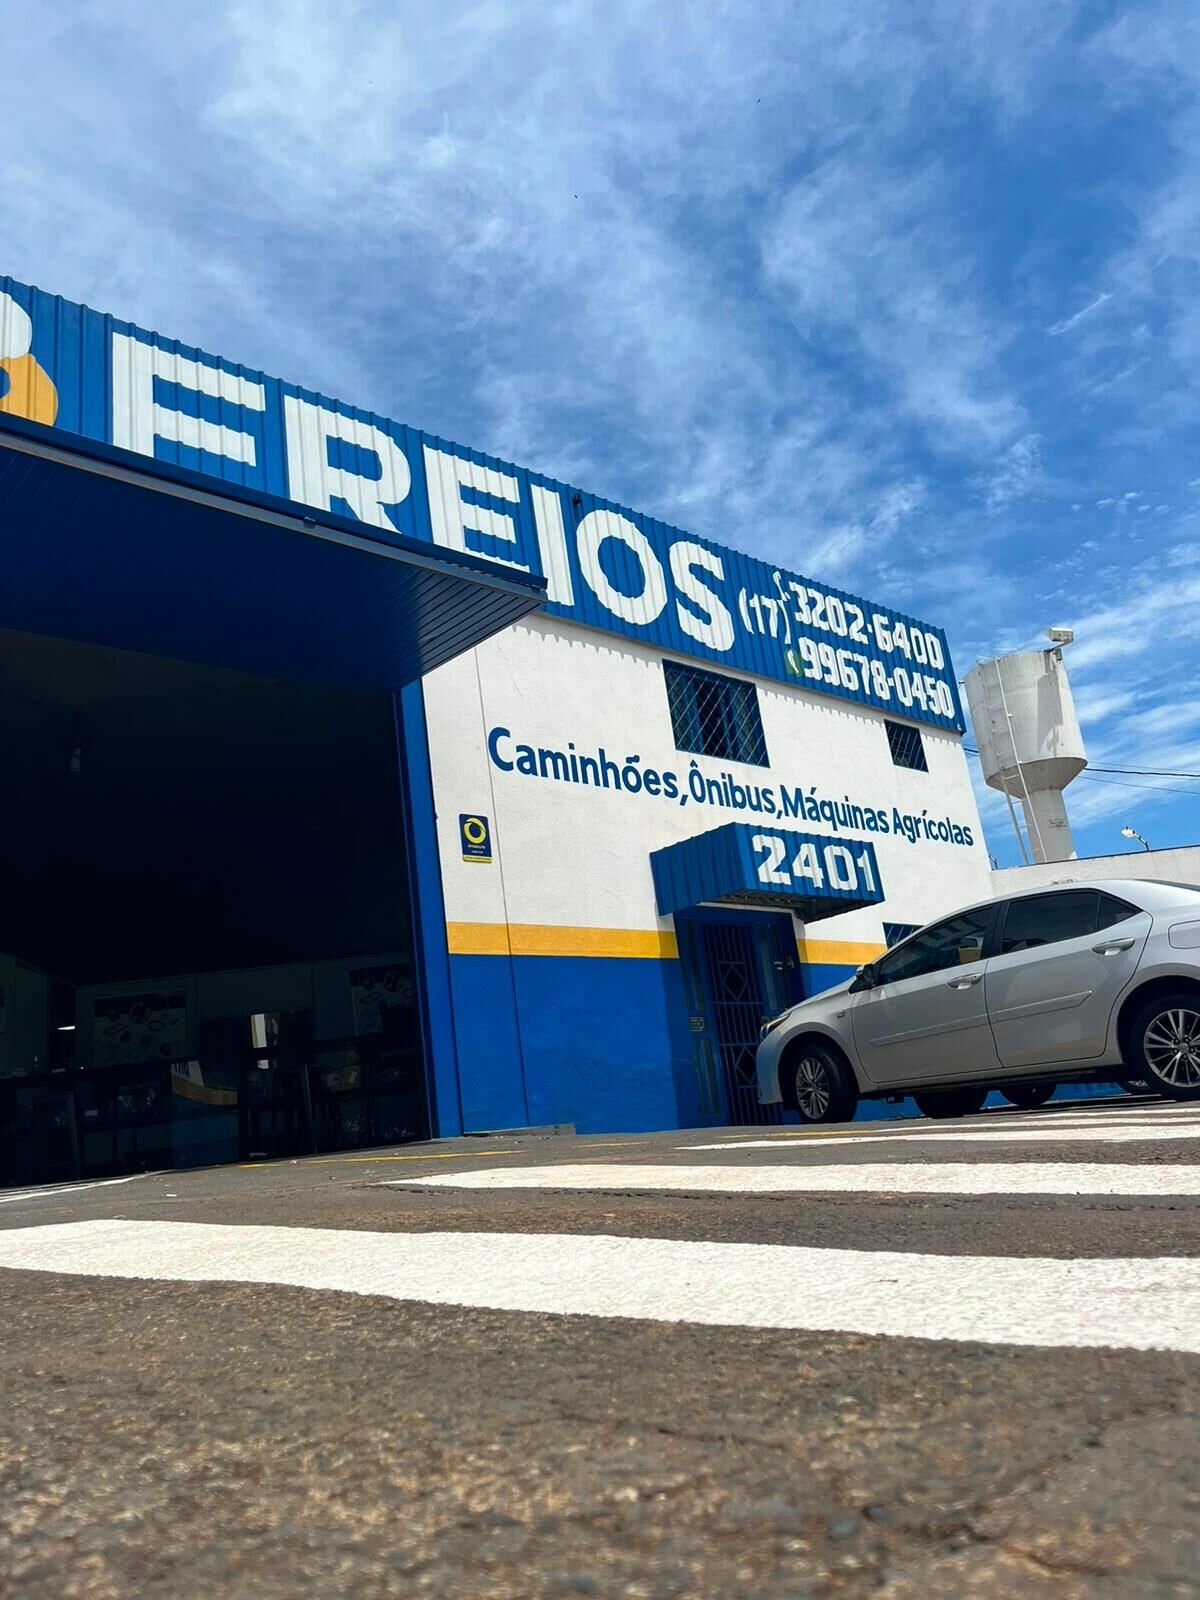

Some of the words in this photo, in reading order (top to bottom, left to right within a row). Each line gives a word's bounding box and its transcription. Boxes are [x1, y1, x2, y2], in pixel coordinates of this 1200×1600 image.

[112, 331, 735, 652] FREIOS
[739, 587, 791, 645] (17)
[789, 581, 945, 671] 3202-6400
[798, 636, 956, 719] 99678-0450
[780, 784, 890, 832] Máquinas
[893, 807, 975, 847] Agrícolas
[752, 834, 876, 893] 2401
